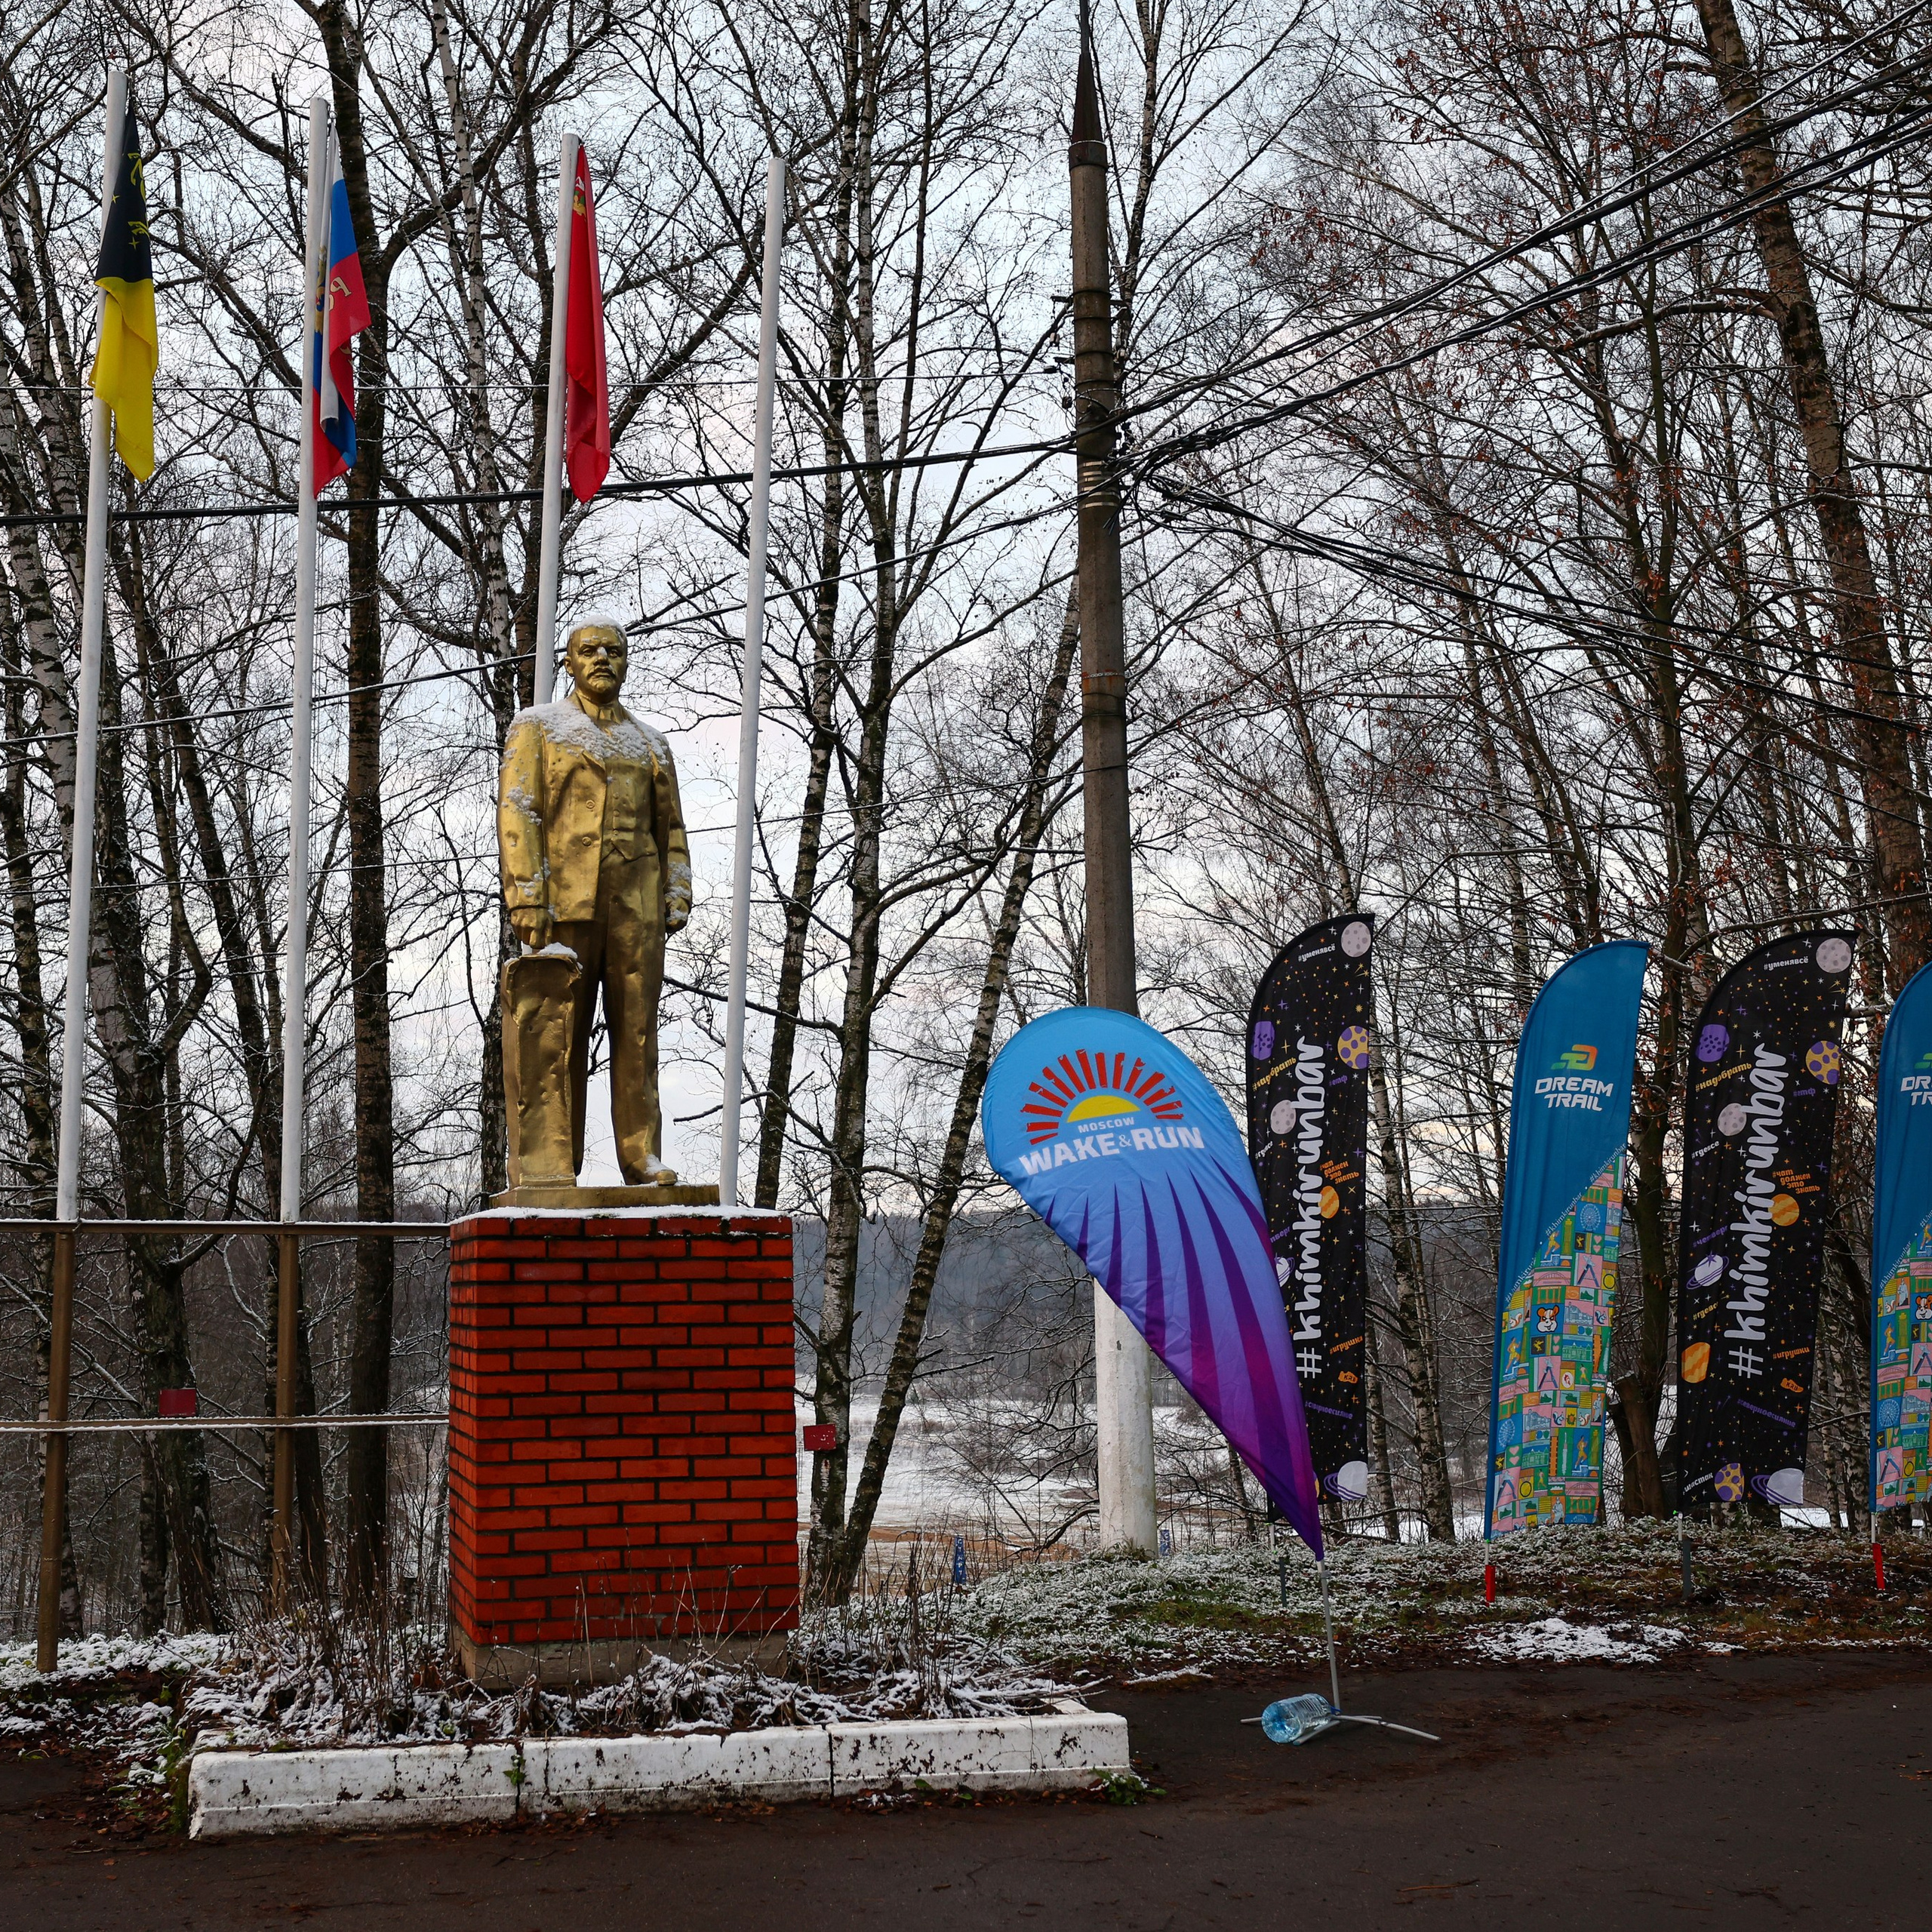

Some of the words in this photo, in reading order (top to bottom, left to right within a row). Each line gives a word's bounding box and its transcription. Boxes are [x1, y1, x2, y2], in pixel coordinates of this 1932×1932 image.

[1297, 943, 1337, 963] #уменявсё
[1764, 955, 1809, 971] #уменявсё
[1534, 1076, 1614, 1097] DREAM
[1543, 1093, 1603, 1112] TRAIL
[1078, 1117, 1135, 1134] MOSCOW
